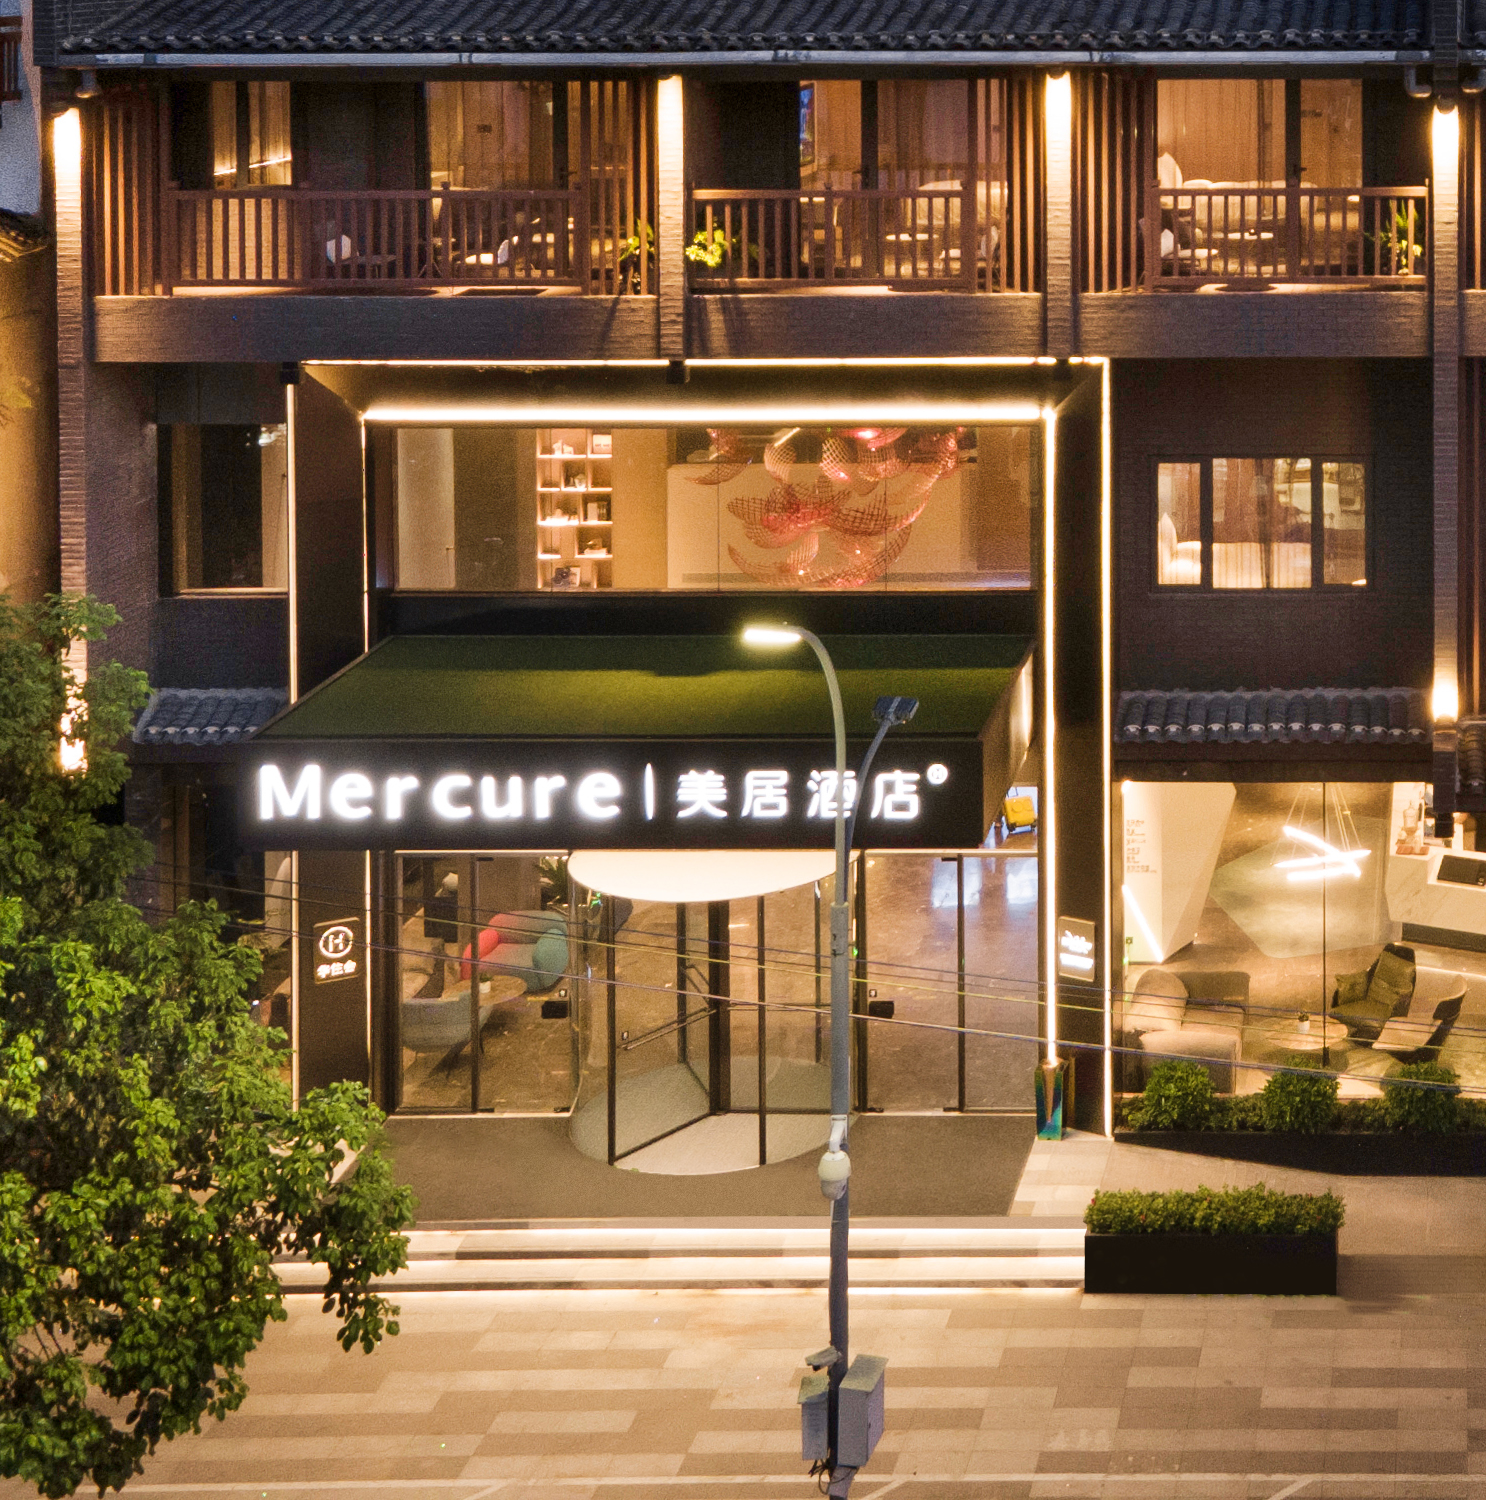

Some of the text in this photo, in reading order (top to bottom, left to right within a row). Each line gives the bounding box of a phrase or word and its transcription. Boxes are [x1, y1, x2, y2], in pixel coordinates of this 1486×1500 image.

[257, 763, 623, 821] Mercure
[676, 769, 921, 819] 美居酒店
